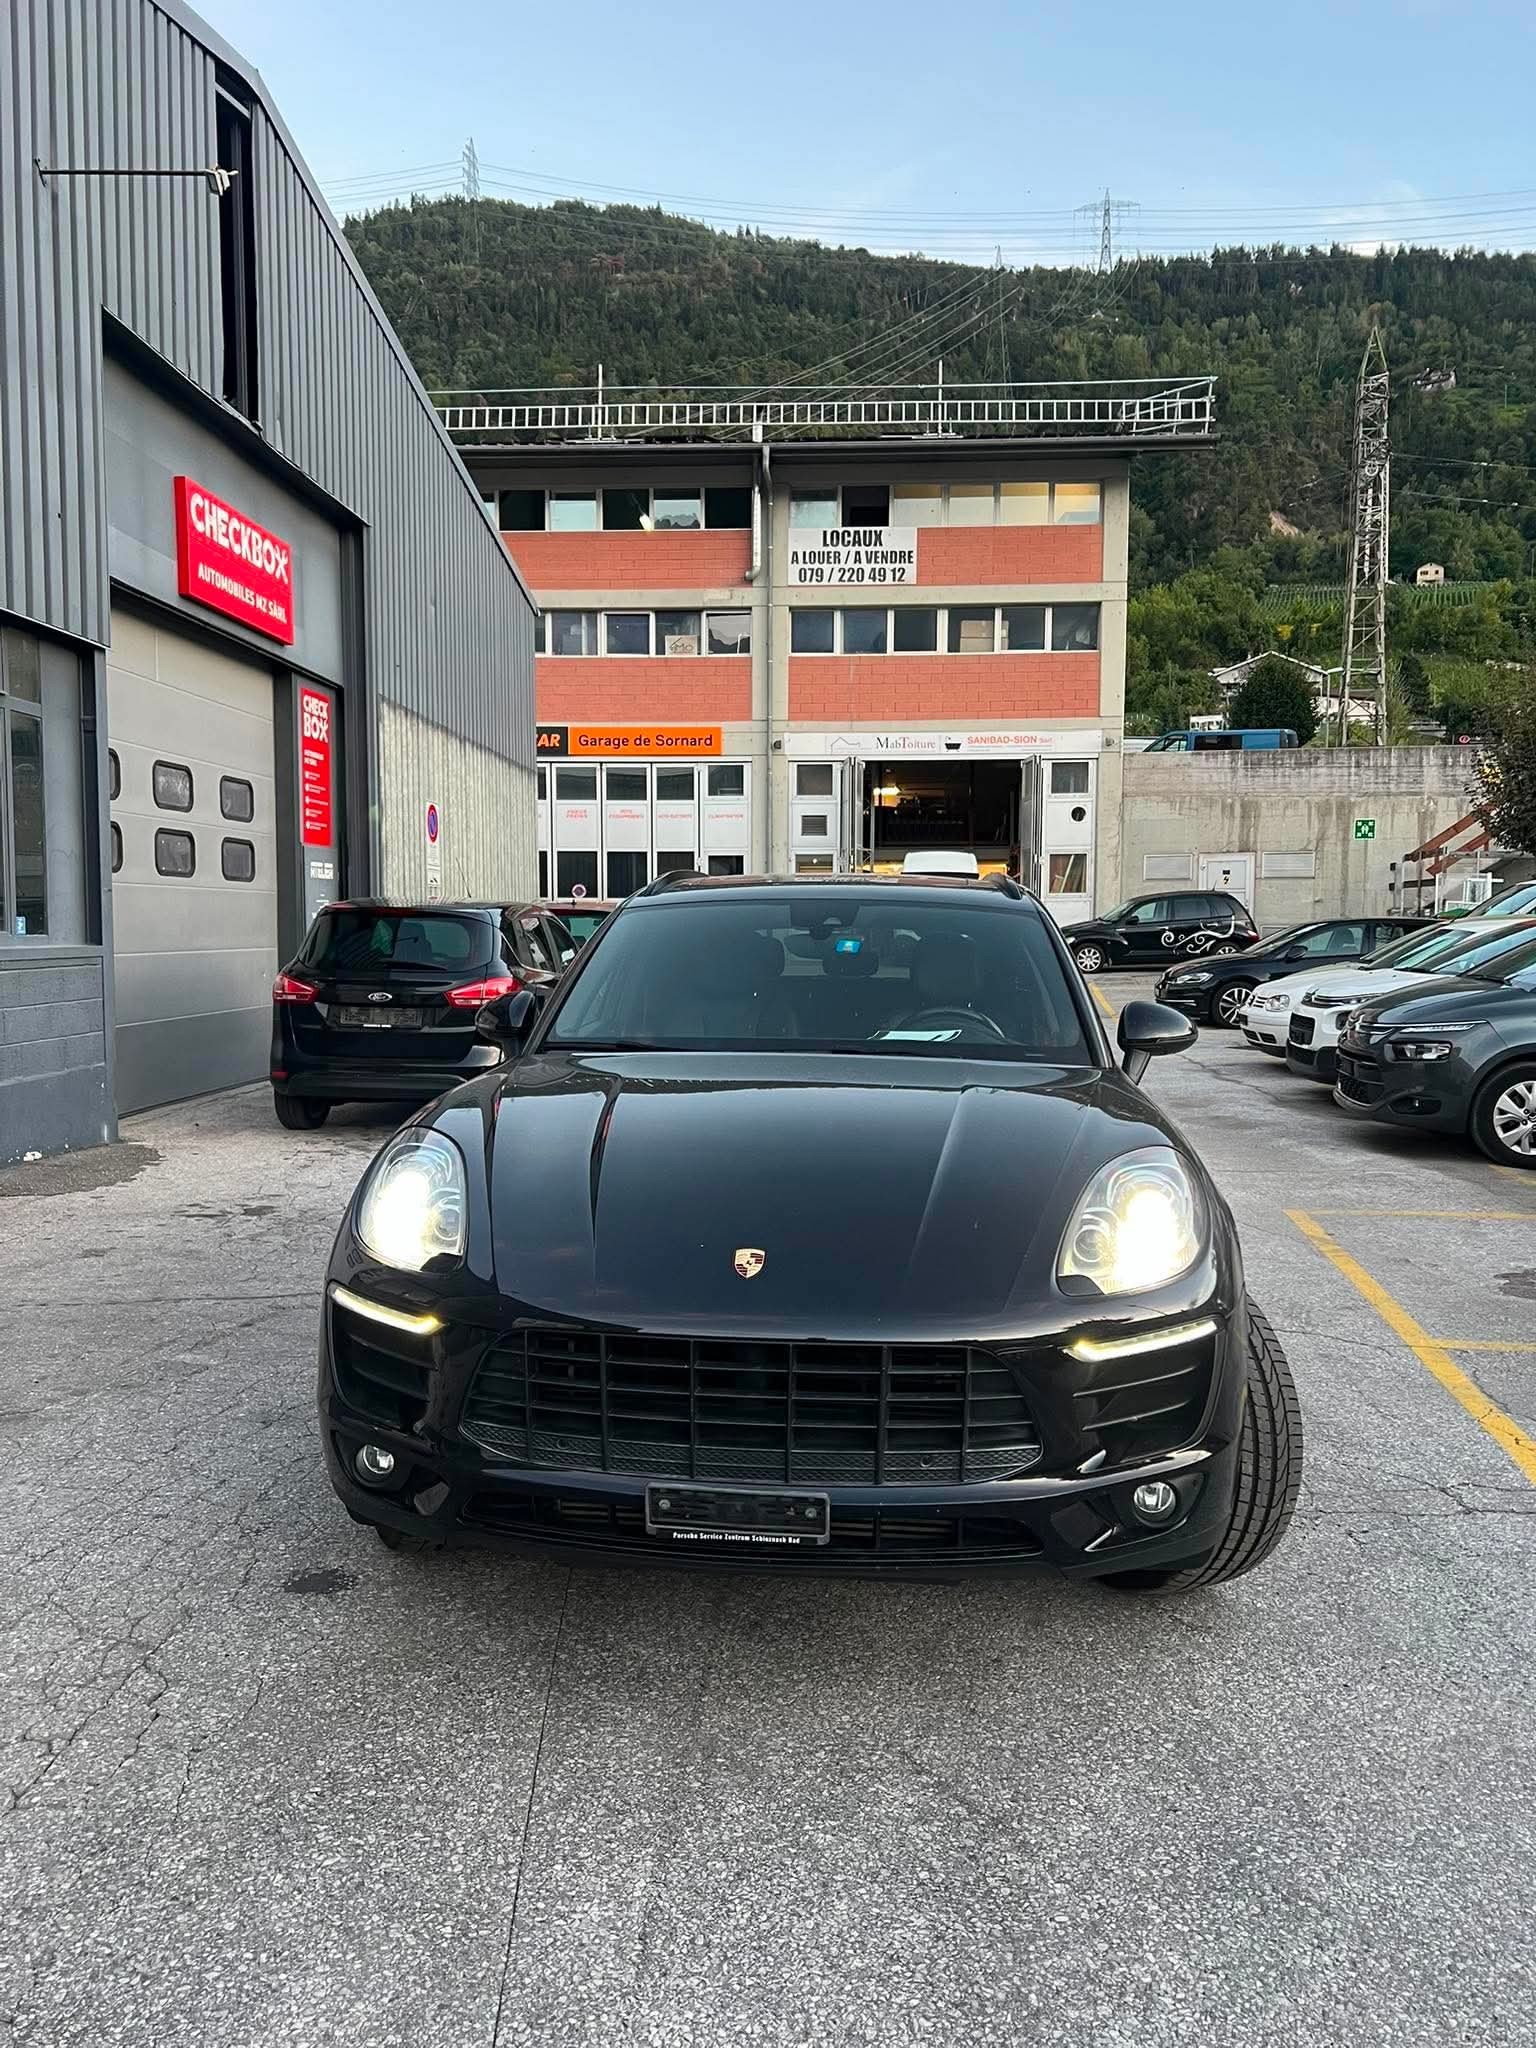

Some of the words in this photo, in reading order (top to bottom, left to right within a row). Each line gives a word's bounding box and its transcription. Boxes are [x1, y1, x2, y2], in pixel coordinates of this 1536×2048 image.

[190, 493, 288, 584] CHECKBOX
[822, 530, 883, 547] LOCAUX
[791, 551, 799, 564] A
[803, 551, 841, 565] LOUER
[844, 551, 850, 564] /
[854, 551, 862, 564] A
[865, 550, 914, 564] VENDRE
[799, 568, 824, 583] 079
[828, 568, 834, 582] /
[838, 567, 865, 583] 220
[868, 567, 887, 582] 49
[891, 567, 906, 582] 12
[198, 562, 255, 607] AUTOMOBILES
[303, 694, 328, 720] CHECK
[303, 712, 328, 743] BOX
[536, 733, 560, 747] AR
[578, 735, 629, 749] Garage
[634, 734, 651, 746] de
[655, 734, 712, 746] Sornard
[876, 736, 936, 749] MabToiture
[672, 1531, 698, 1540] Porsche
[699, 1532, 722, 1541] Service
[724, 1533, 750, 1542] Zentrum
